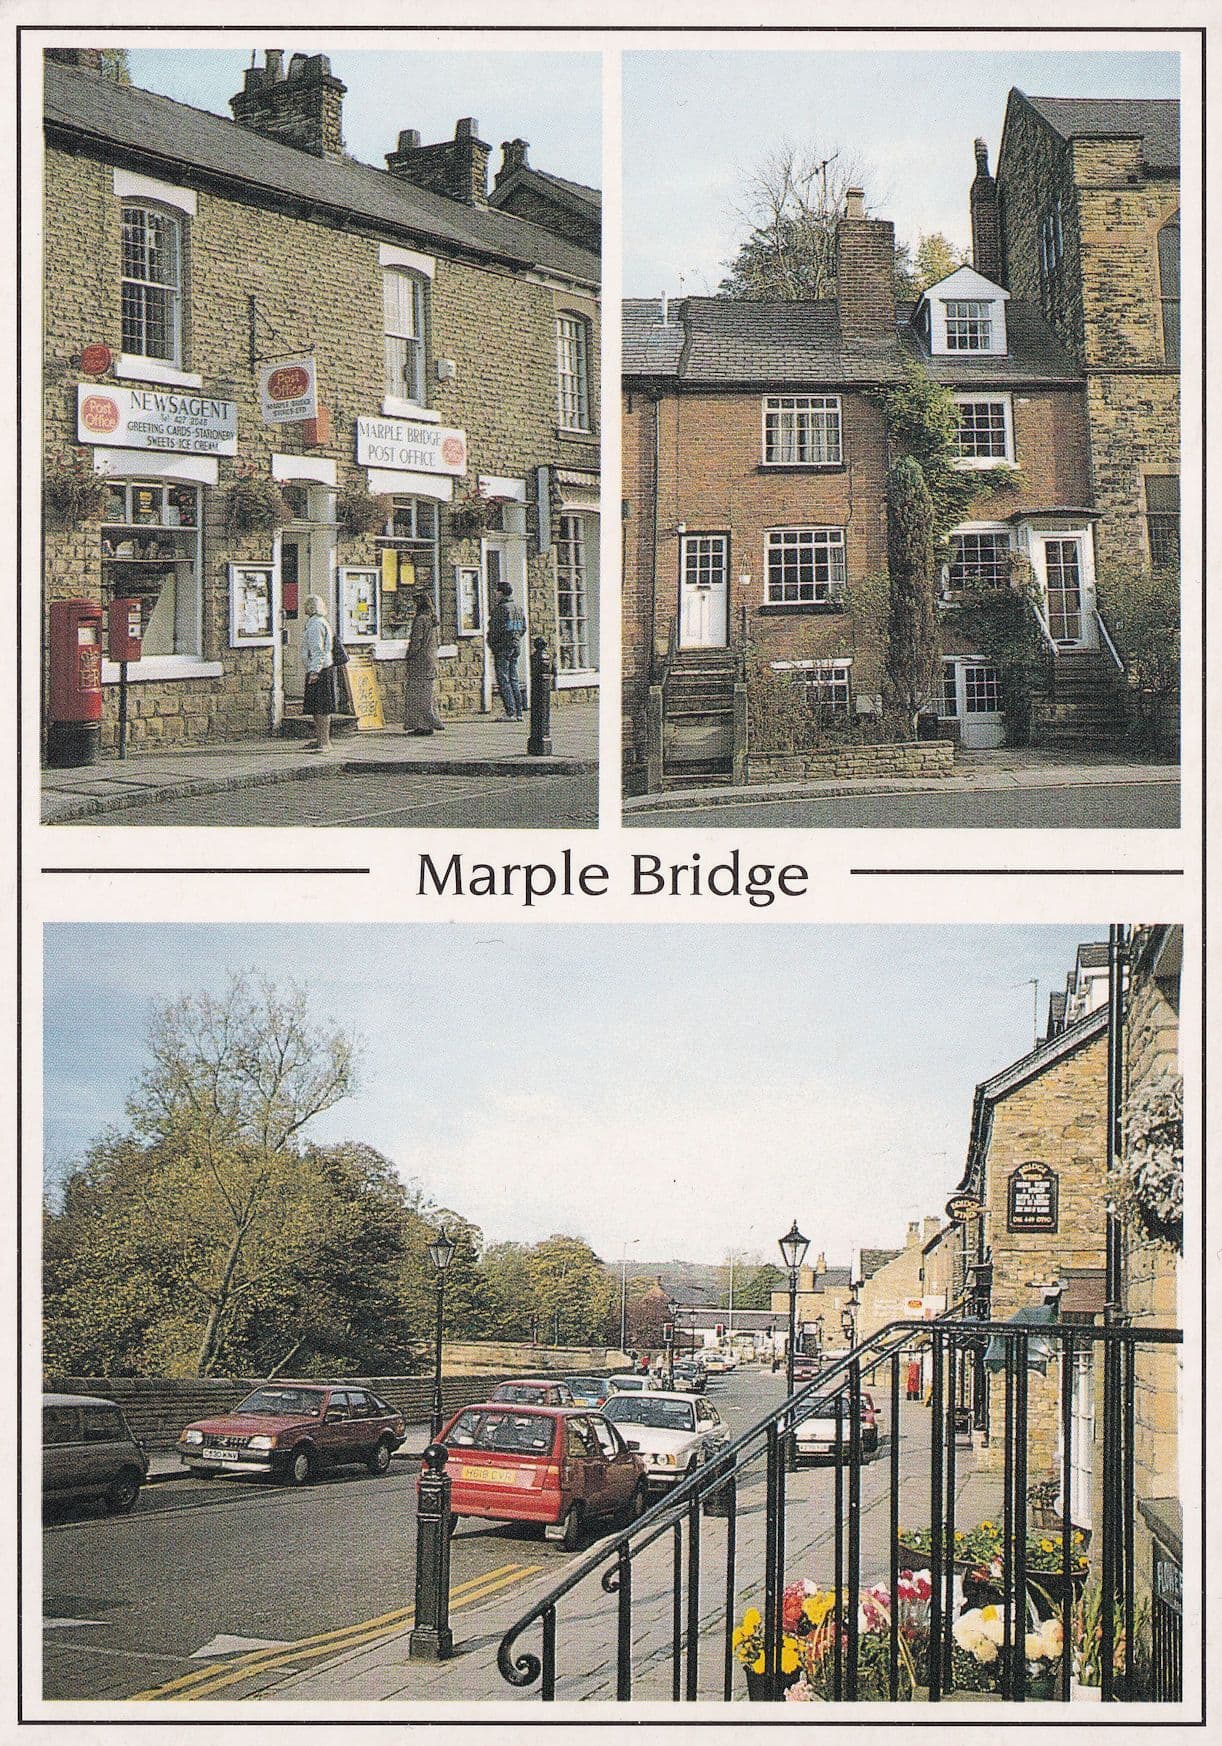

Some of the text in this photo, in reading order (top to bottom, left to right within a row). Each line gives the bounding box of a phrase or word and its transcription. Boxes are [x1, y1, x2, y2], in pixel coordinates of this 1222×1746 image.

[277, 371, 300, 384] Post
[273, 384, 305, 397] Office
[90, 400, 113, 414] Post
[130, 391, 230, 420] NEWSAGENT
[86, 412, 116, 426] Office
[127, 421, 165, 434] GREETING
[359, 421, 442, 446] MARPLE BRIDGE
[368, 443, 397, 462] POST
[399, 447, 436, 467] OFFICE
